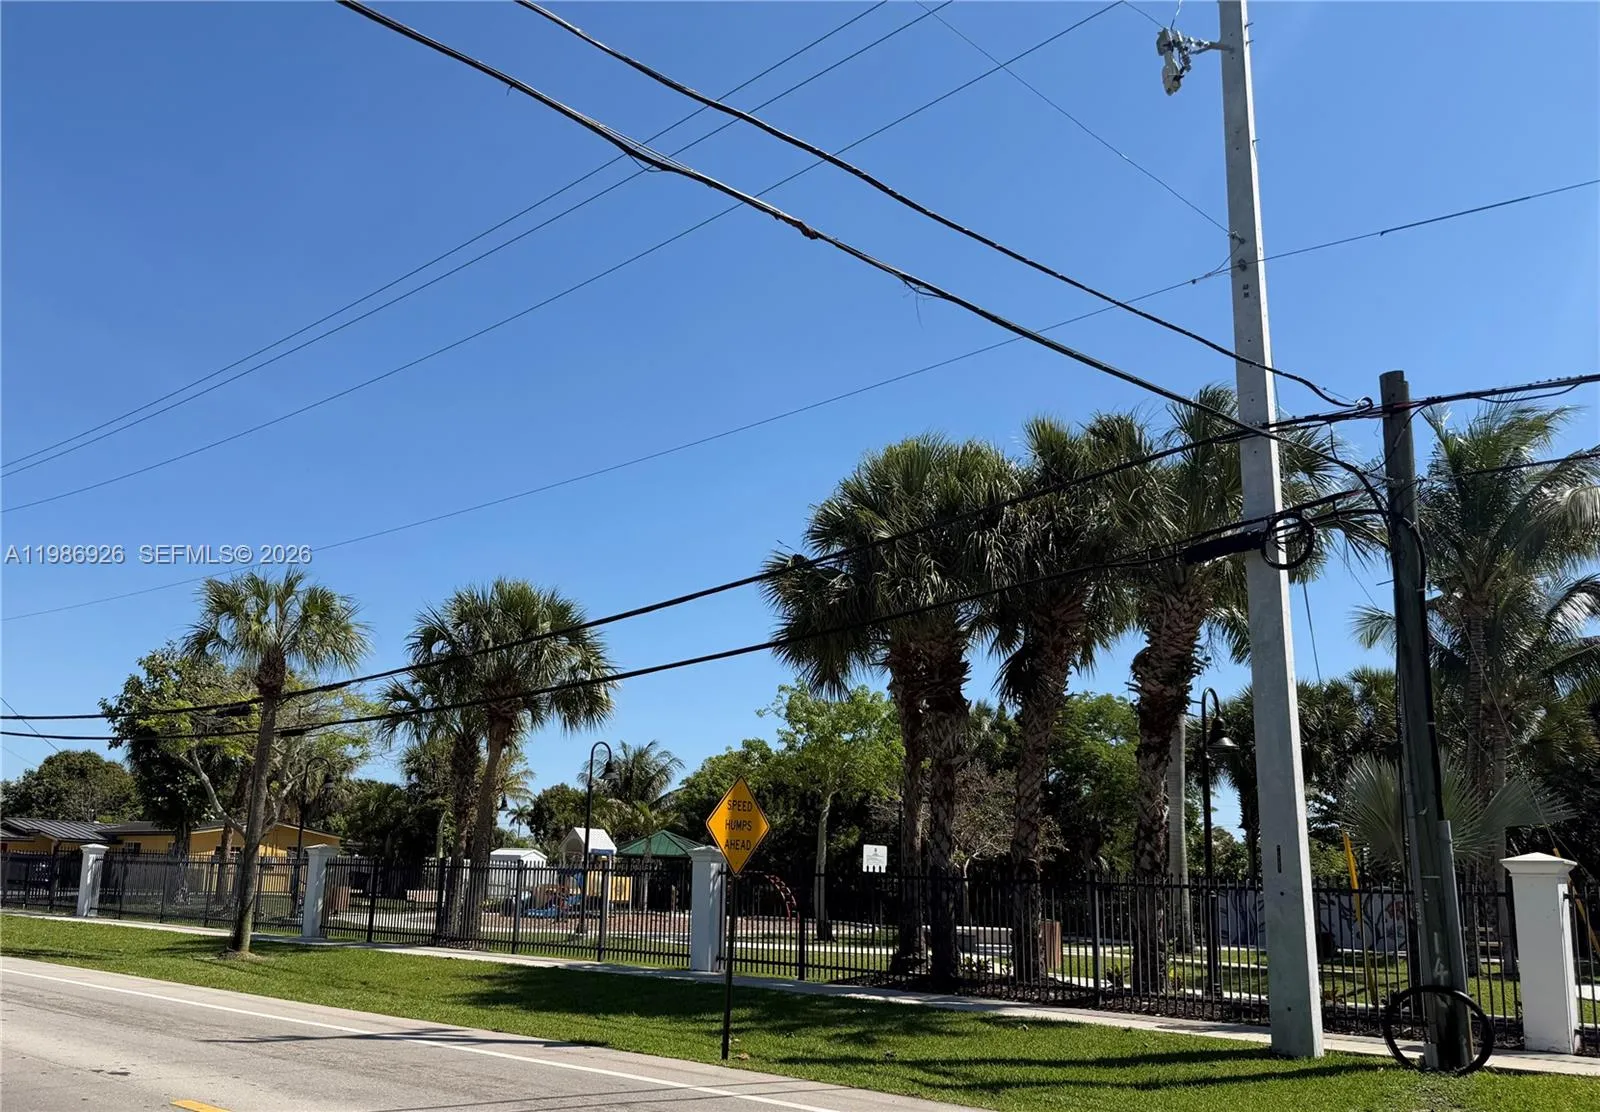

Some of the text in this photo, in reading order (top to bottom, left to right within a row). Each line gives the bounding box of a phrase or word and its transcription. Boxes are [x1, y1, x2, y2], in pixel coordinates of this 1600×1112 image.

[727, 799, 753, 812] SPEED
[725, 819, 752, 831] HUMPS
[724, 839, 752, 851] AHEAD
